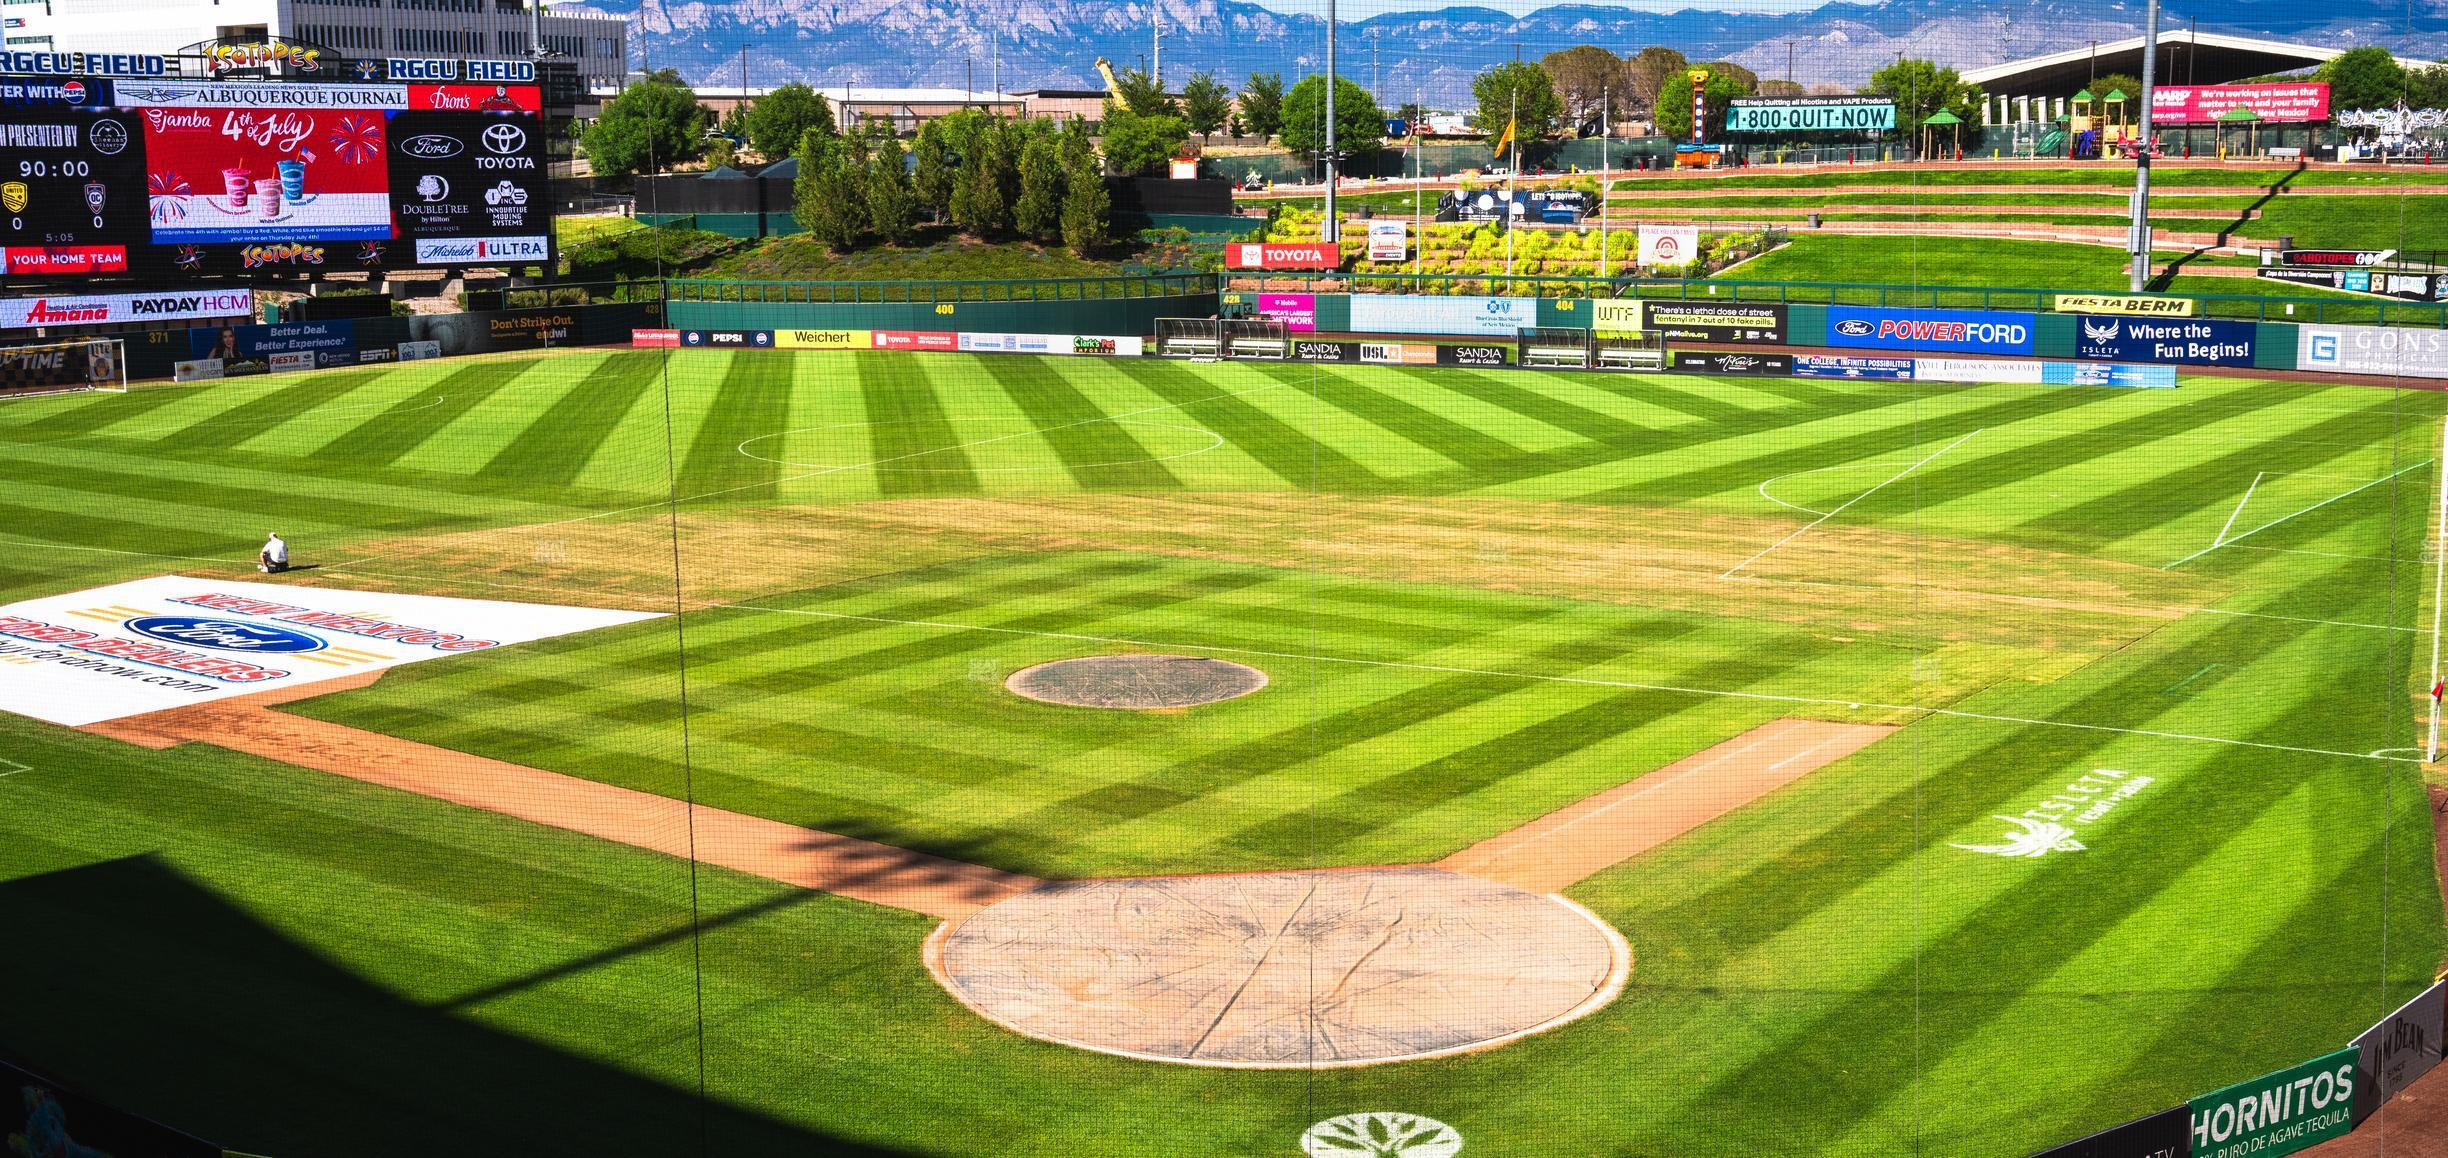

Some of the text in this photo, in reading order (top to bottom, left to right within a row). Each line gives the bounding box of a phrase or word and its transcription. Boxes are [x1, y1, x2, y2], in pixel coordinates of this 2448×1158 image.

[203, 41, 320, 73] ISOTOPES
[85, 53, 165, 75] FIELD
[387, 58, 535, 82] RGCU FIELD
[27, 85, 64, 98] WITH
[197, 90, 407, 106] ALBUQUERQUE JOURNAL
[430, 86, 470, 109] Dion's
[2201, 90, 2225, 98] We're
[2225, 90, 2260, 99] working
[2273, 88, 2298, 97] issues
[2299, 87, 2318, 96] that
[1748, 99, 1763, 107] Help
[1764, 99, 1790, 107] Quitting
[2198, 99, 2226, 108] matter
[2254, 99, 2271, 107] and
[2272, 100, 2292, 109] your
[2293, 98, 2319, 107] family
[2258, 109, 2309, 117] New Mexico!
[161, 110, 212, 133] jamba
[8, 125, 77, 147] PRESENTED BY
[257, 112, 315, 152] July
[413, 137, 451, 154] Ford
[475, 157, 535, 169] TOYOTA
[12, 217, 23, 230] 0
[93, 216, 103, 229] 0
[46, 233, 74, 242] 5:05
[240, 241, 325, 268] ISOTOPES
[421, 243, 543, 258] Michelob ULTRA
[1265, 250, 1322, 261] TOYOTA
[13, 253, 122, 265] YOUR HOME TEAM
[132, 294, 249, 314] PAYDAY HCM
[935, 304, 954, 314] 400
[2062, 297, 2185, 312] FIESTA BERM
[26, 299, 109, 323] Amana
[1599, 307, 1634, 321] WTF
[1655, 305, 1684, 314] There's
[1692, 307, 1716, 315] lethal
[1716, 307, 1737, 315] dose
[1738, 307, 1748, 316] of
[1748, 309, 1773, 317] street
[490, 315, 574, 329] Don't Strike Out.
[1655, 315, 1688, 324] fentanyl
[1717, 316, 1725, 324] of
[1755, 318, 1774, 327] pills.
[270, 324, 328, 337] Better Deal.
[1842, 322, 1868, 334] Ford
[2129, 324, 2211, 340] Where the
[149, 331, 169, 343] 371
[712, 333, 743, 342] PEPSI
[794, 331, 851, 343] Weichert
[1073, 336, 1116, 348] Clark's Pet
[255, 341, 287, 351] Better
[1299, 343, 1341, 354] SANDIA
[2082, 346, 2120, 354] ISLETA
[2155, 341, 2249, 362] Fun Begins!
[1456, 347, 1502, 359] SANDIA
[21, 352, 65, 370] TIME
[270, 355, 299, 365] FIESTA
[1797, 357, 1810, 365] ONE
[1840, 358, 1867, 367] INFINITE
[1868, 359, 1911, 368] POSSIBILITIES
[165, 593, 501, 651] NEW MEXICO
[150, 621, 293, 648] Ford
[58, 636, 292, 682] DEALERS
[2369, 1016, 2424, 1097] JIM BEAM
[2190, 1064, 2353, 1148] HORNITOS
[2217, 1107, 2350, 1158] PURO DE AGAVE TEQUILA
